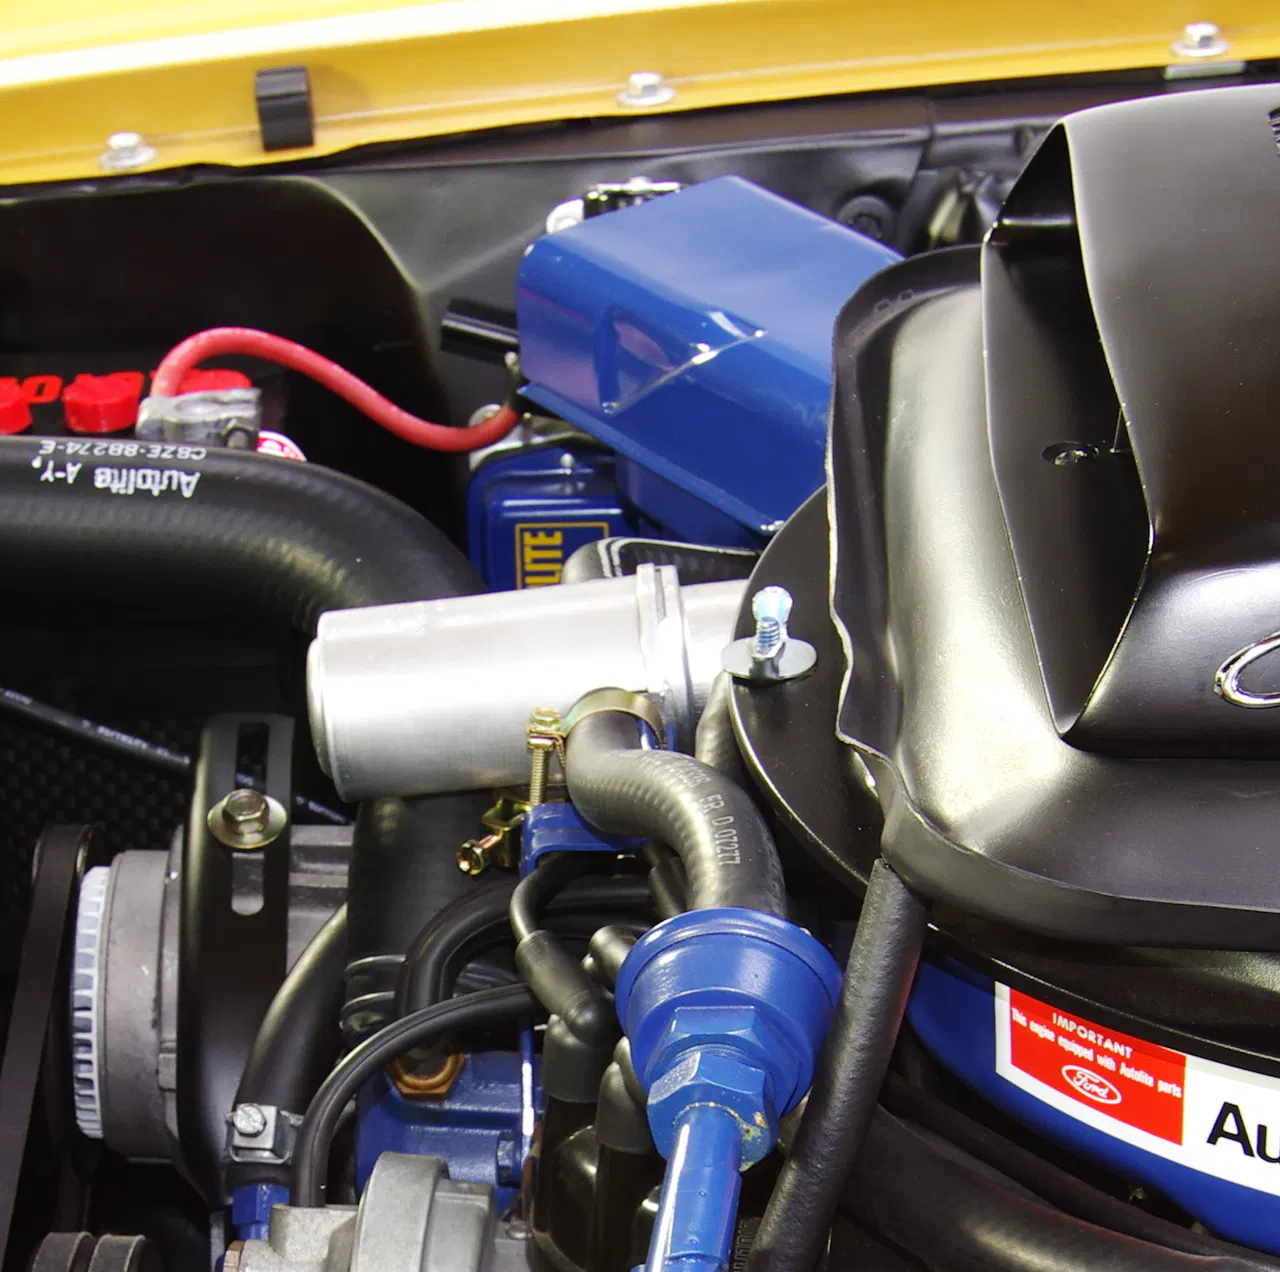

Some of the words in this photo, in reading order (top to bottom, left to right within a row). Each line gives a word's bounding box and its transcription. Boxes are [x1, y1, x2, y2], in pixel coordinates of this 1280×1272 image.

[95, 466, 201, 499] Autolite
[1011, 1008, 1027, 1027] This
[1030, 1021, 1055, 1042] engine
[1058, 1036, 1094, 1061] equipped
[1097, 1054, 1116, 1072] with
[1120, 1062, 1154, 1086] Autolite
[1158, 1080, 1182, 1098] parts
[1052, 1013, 1133, 1058] IMPORTANT
[1073, 1071, 1109, 1099] Ford
